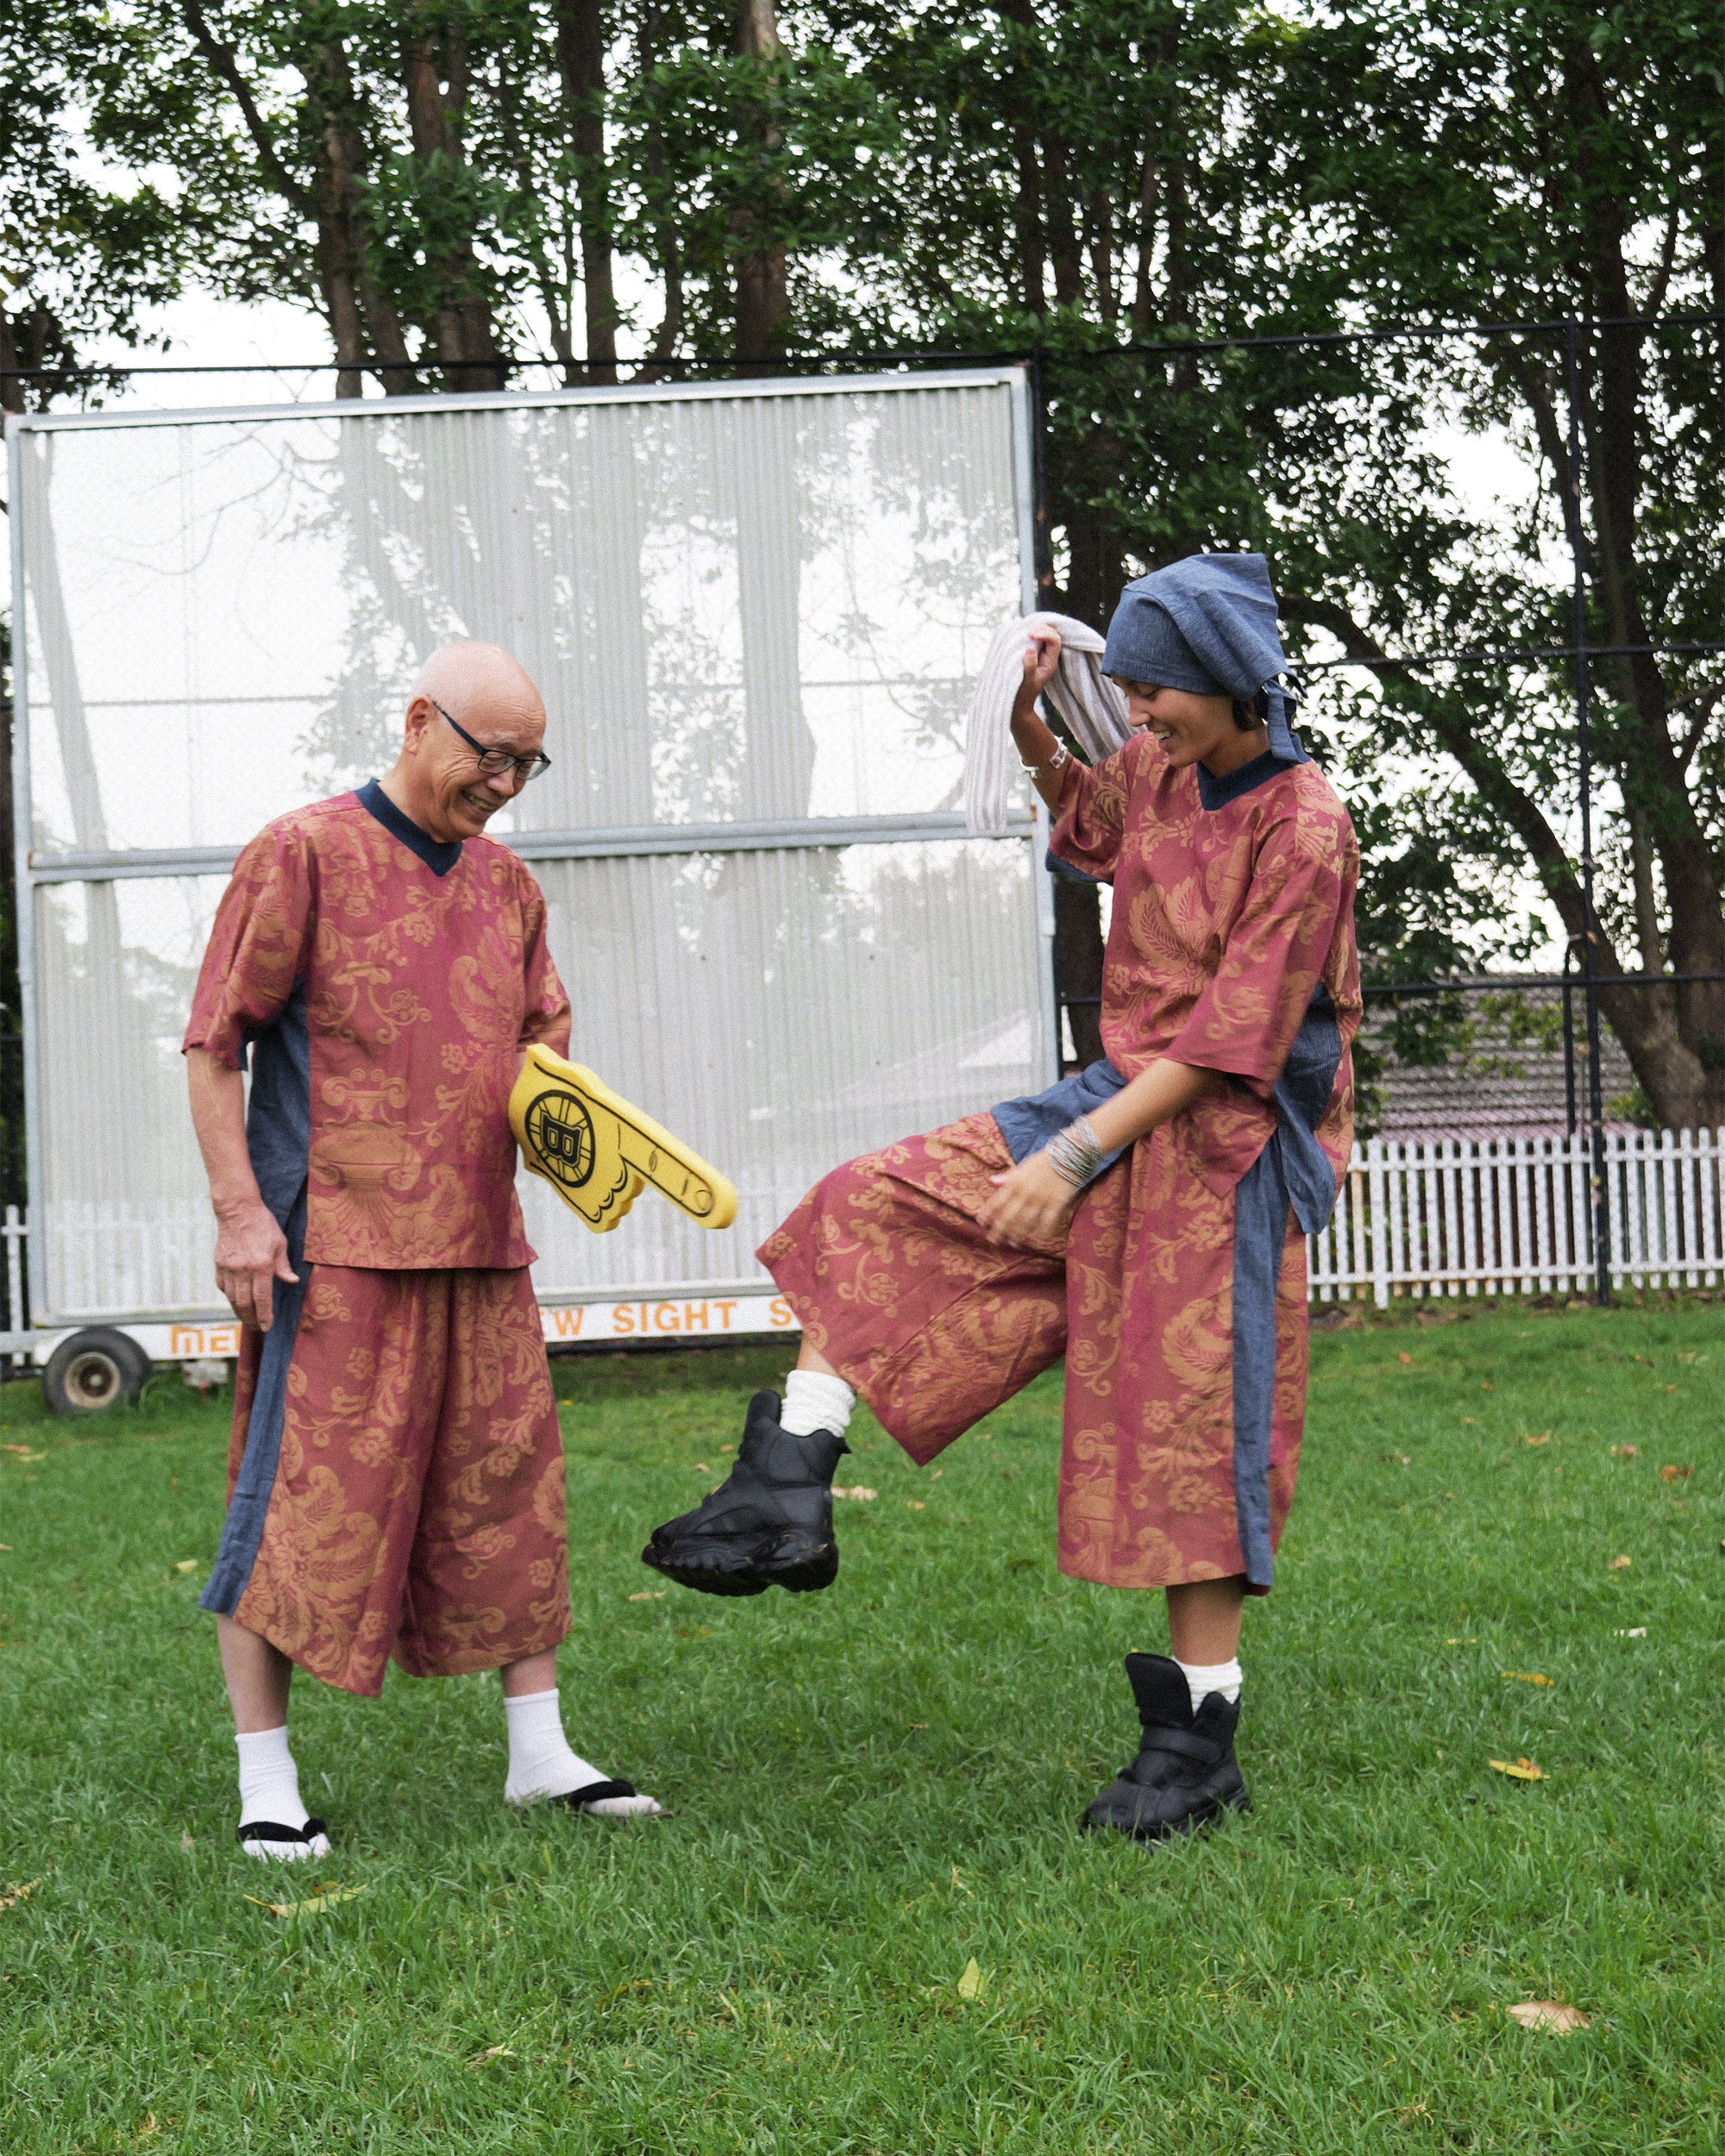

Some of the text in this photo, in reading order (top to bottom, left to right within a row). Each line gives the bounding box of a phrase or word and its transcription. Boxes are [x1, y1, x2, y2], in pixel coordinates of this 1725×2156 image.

[540, 1110, 583, 1169] B
[538, 1306, 585, 1337] W
[612, 1300, 738, 1333] SIGHT
[769, 1298, 793, 1326] S
